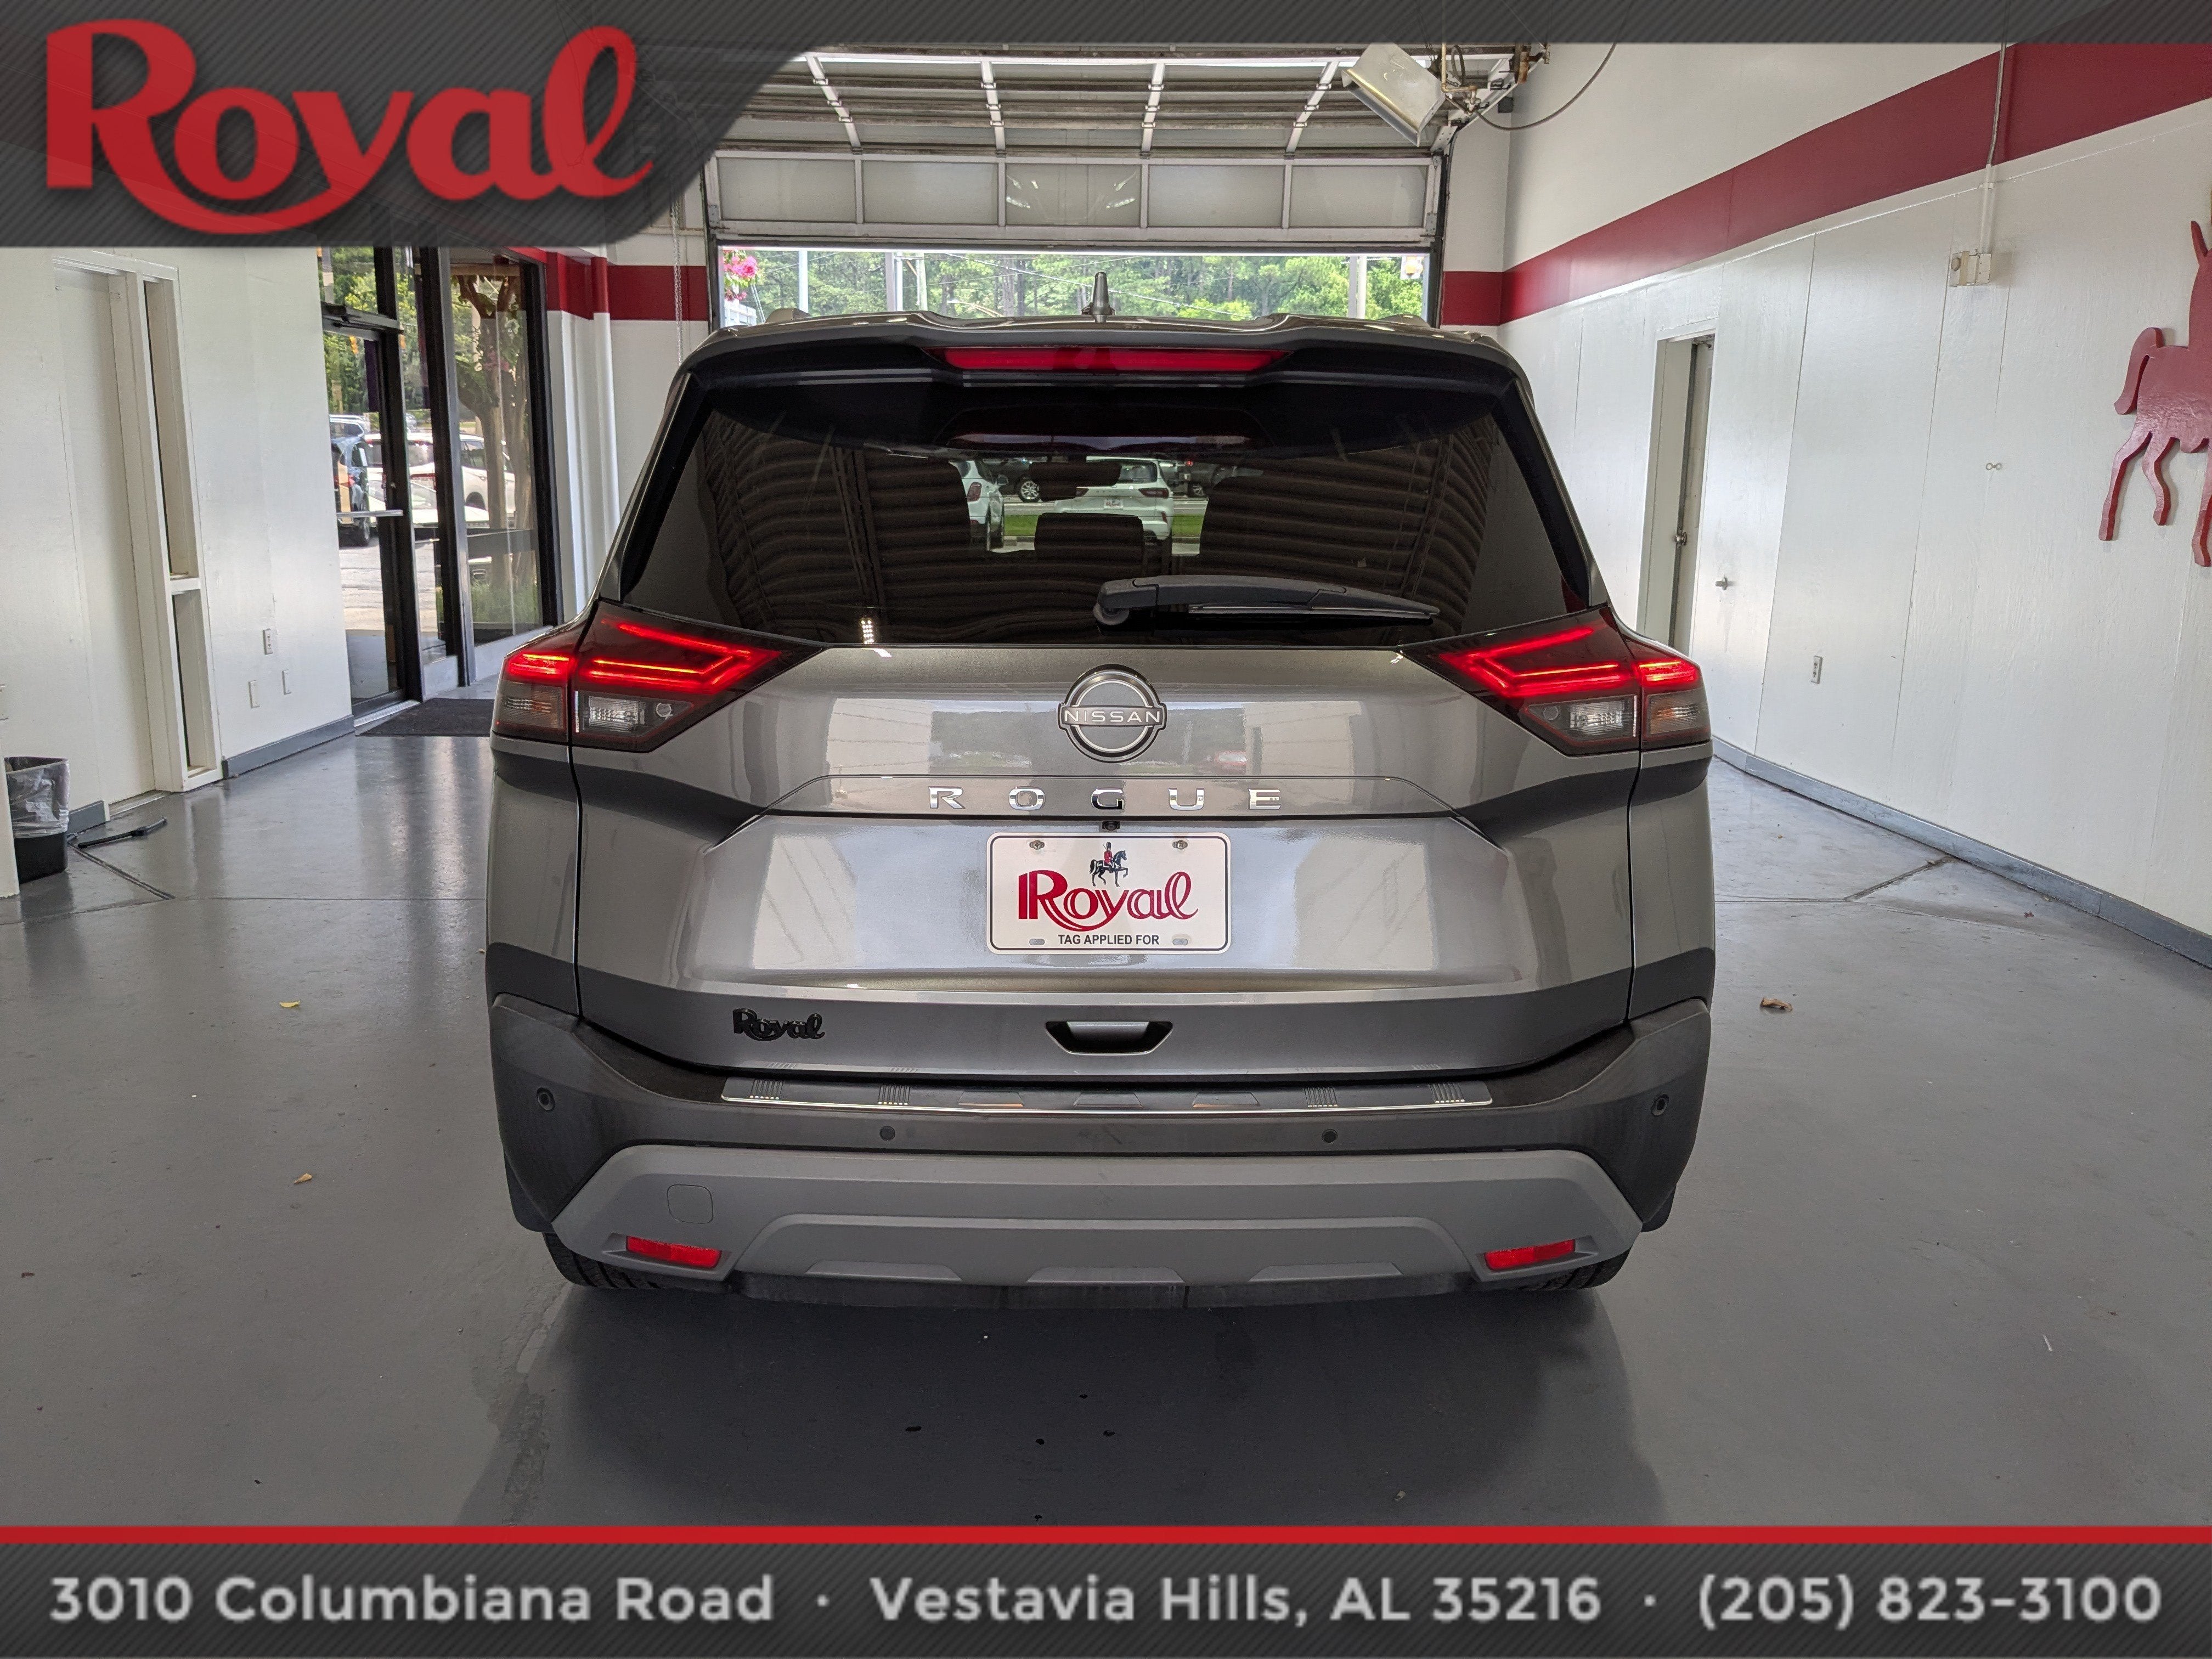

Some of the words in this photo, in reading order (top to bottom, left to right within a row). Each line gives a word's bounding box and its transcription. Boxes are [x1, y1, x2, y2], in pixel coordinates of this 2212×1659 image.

[1064, 710, 1160, 723] NISSAN
[928, 786, 1282, 811] ROGUE
[1018, 870, 1199, 932] Royal
[1058, 934, 1082, 945] TAG
[1084, 934, 1132, 945] APPLIED
[1136, 934, 1160, 945] FOR
[732, 1008, 826, 1041] Royal
